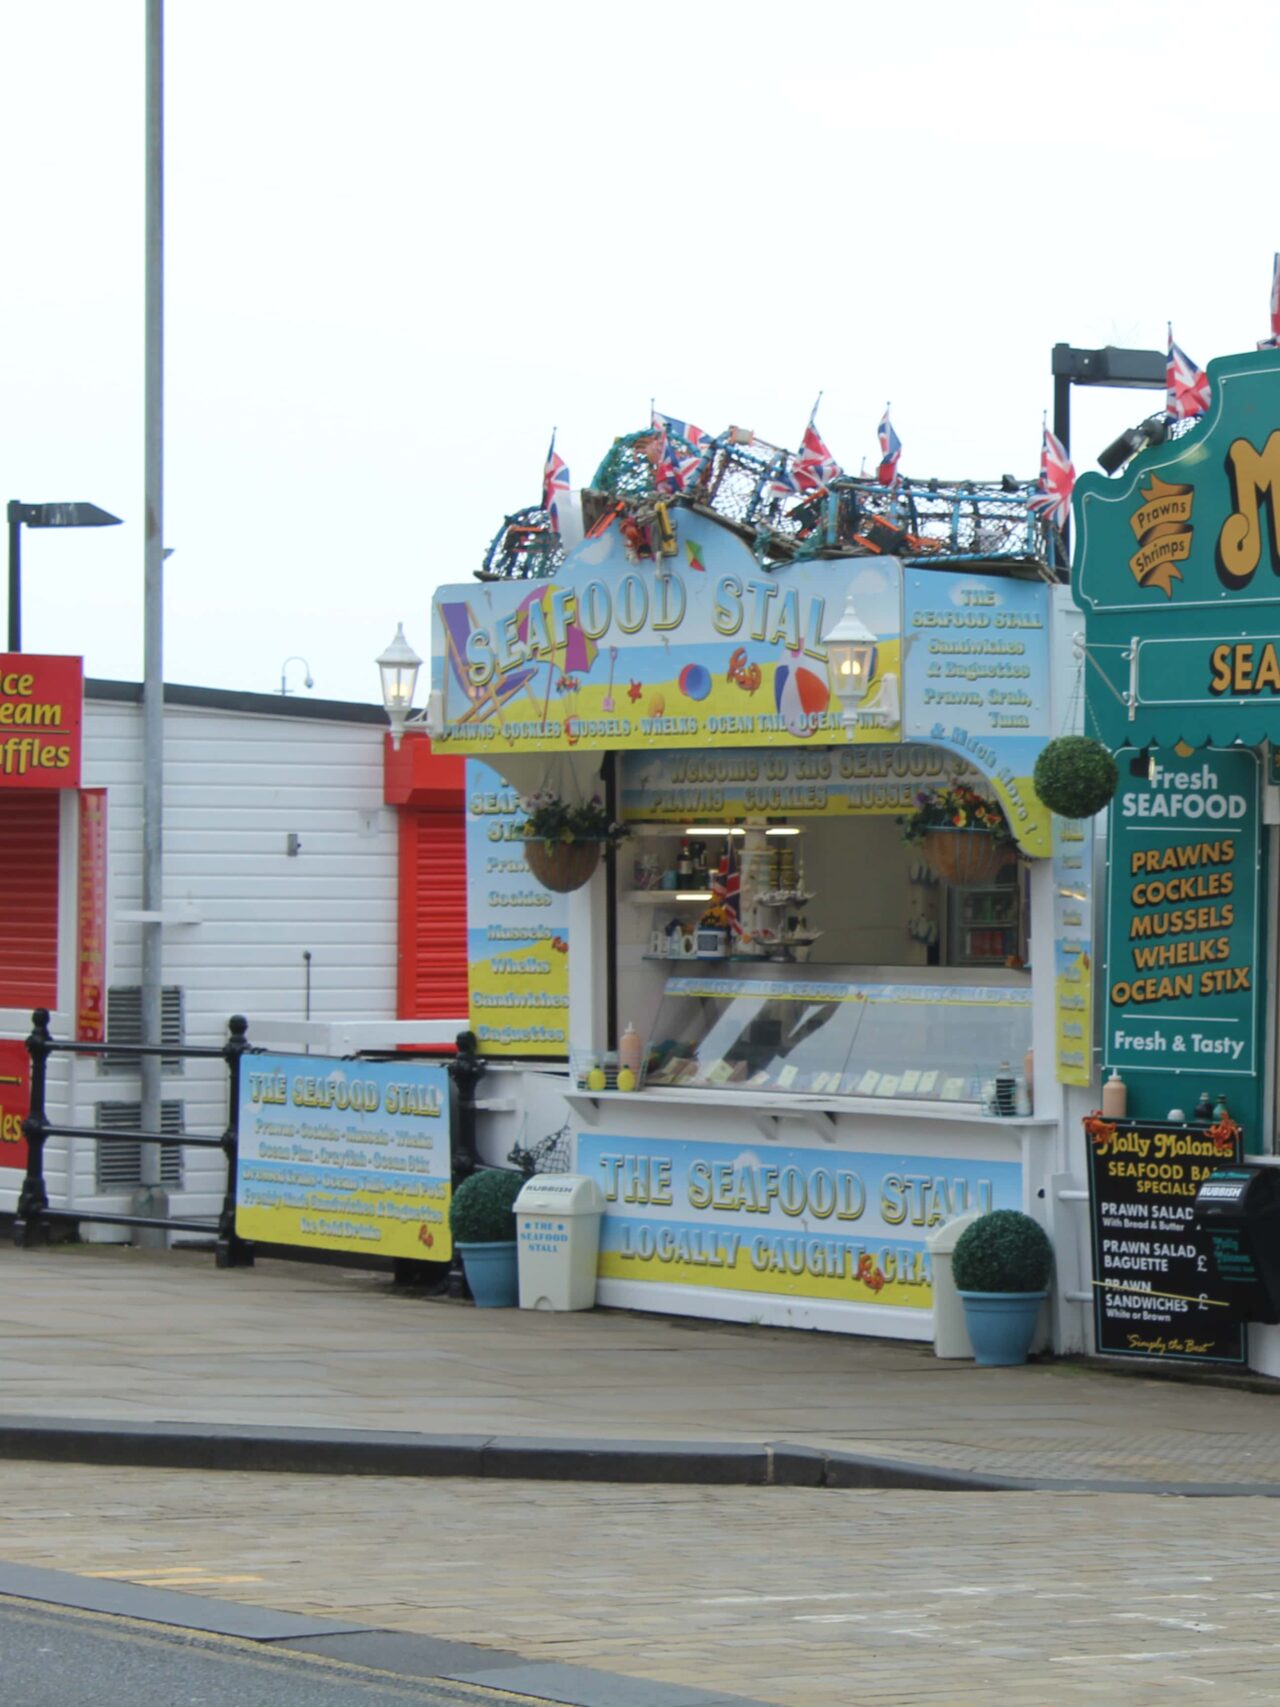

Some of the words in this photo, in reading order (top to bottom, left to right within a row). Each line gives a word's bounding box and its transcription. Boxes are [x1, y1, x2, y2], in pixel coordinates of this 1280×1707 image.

[1137, 501, 1187, 529] Prawns
[1135, 540, 1185, 573] Shrimps
[466, 571, 687, 687] SEAFOOD
[713, 573, 829, 663] STAL
[912, 610, 990, 628] SEAFOOD
[994, 612, 1043, 630] STALL
[0, 671, 35, 697] ce
[502, 719, 561, 740] COCKLES
[569, 719, 631, 737] MUSSELS
[641, 716, 698, 736] WHELKS
[708, 715, 755, 734] OCEAN
[0, 737, 71, 775] ffles
[1150, 763, 1219, 791] Fresh
[1122, 793, 1247, 820] SEAFOOD
[1131, 839, 1235, 876] PRAWNS
[1131, 872, 1234, 906] COCKLES
[1130, 905, 1234, 939] MUSSELS
[1133, 937, 1230, 970] WHELKS
[1111, 974, 1195, 1006] OCEAN
[1200, 966, 1251, 995] STIX
[1114, 1031, 1168, 1052] Fresh
[1172, 1034, 1187, 1052] &
[1191, 1034, 1245, 1060] Tasty
[249, 1071, 288, 1104] THE
[291, 1075, 380, 1113] SEAFOOD
[385, 1080, 441, 1118] STALL
[1108, 1161, 1184, 1180] SEAFOOD
[601, 1152, 673, 1206] THE
[688, 1157, 867, 1221] SEAFOOD
[1136, 1180, 1197, 1196] SPECIALS
[1198, 1186, 1242, 1198] RUBBISH
[1101, 1202, 1148, 1217] PRAWN
[1151, 1205, 1194, 1220] SALAD
[620, 1223, 741, 1268] LOCALLY
[750, 1233, 867, 1280] CAUGHT
[879, 1245, 933, 1288] CRA
[1103, 1255, 1168, 1272] BAGUETTE
[1197, 1255, 1208, 1272] £
